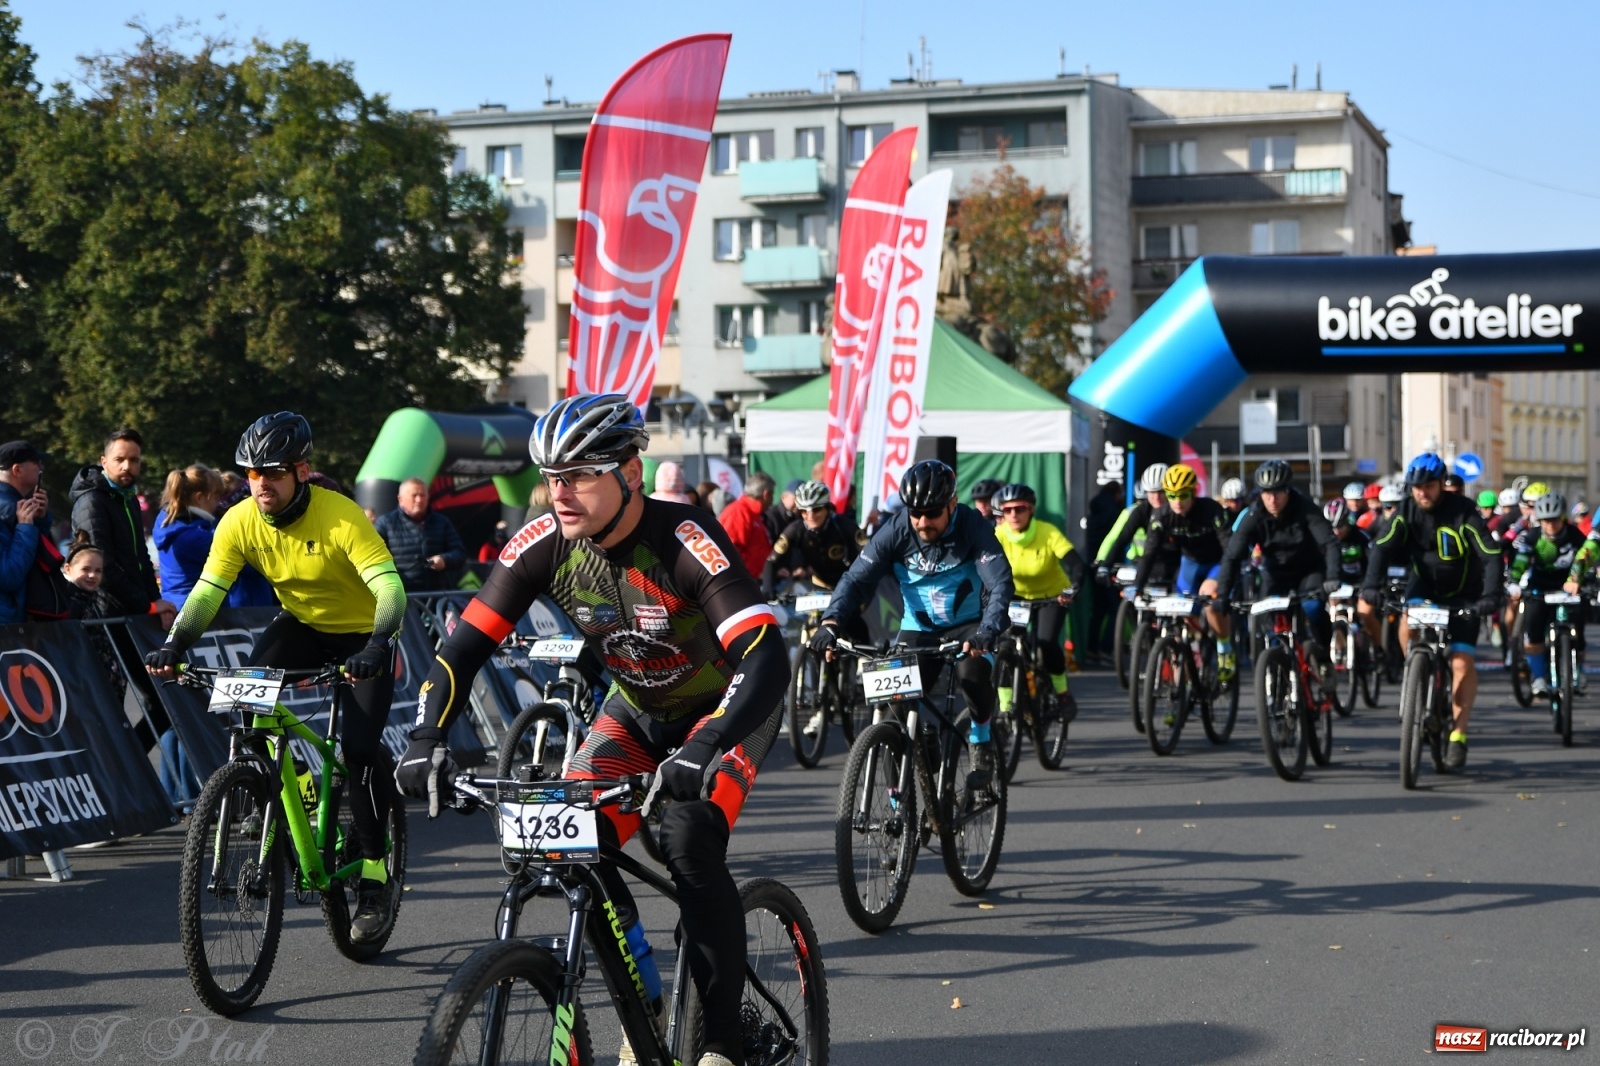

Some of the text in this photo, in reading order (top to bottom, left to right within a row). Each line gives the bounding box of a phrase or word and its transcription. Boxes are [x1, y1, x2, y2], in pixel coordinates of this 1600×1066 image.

[1318, 292, 1583, 341] bike atelier
[883, 217, 927, 505] RACIBÓRZ
[1096, 440, 1124, 485] lier
[541, 643, 573, 653] 3290
[224, 683, 267, 698] 1873
[875, 674, 912, 691] 2254
[514, 815, 579, 840] 1236
